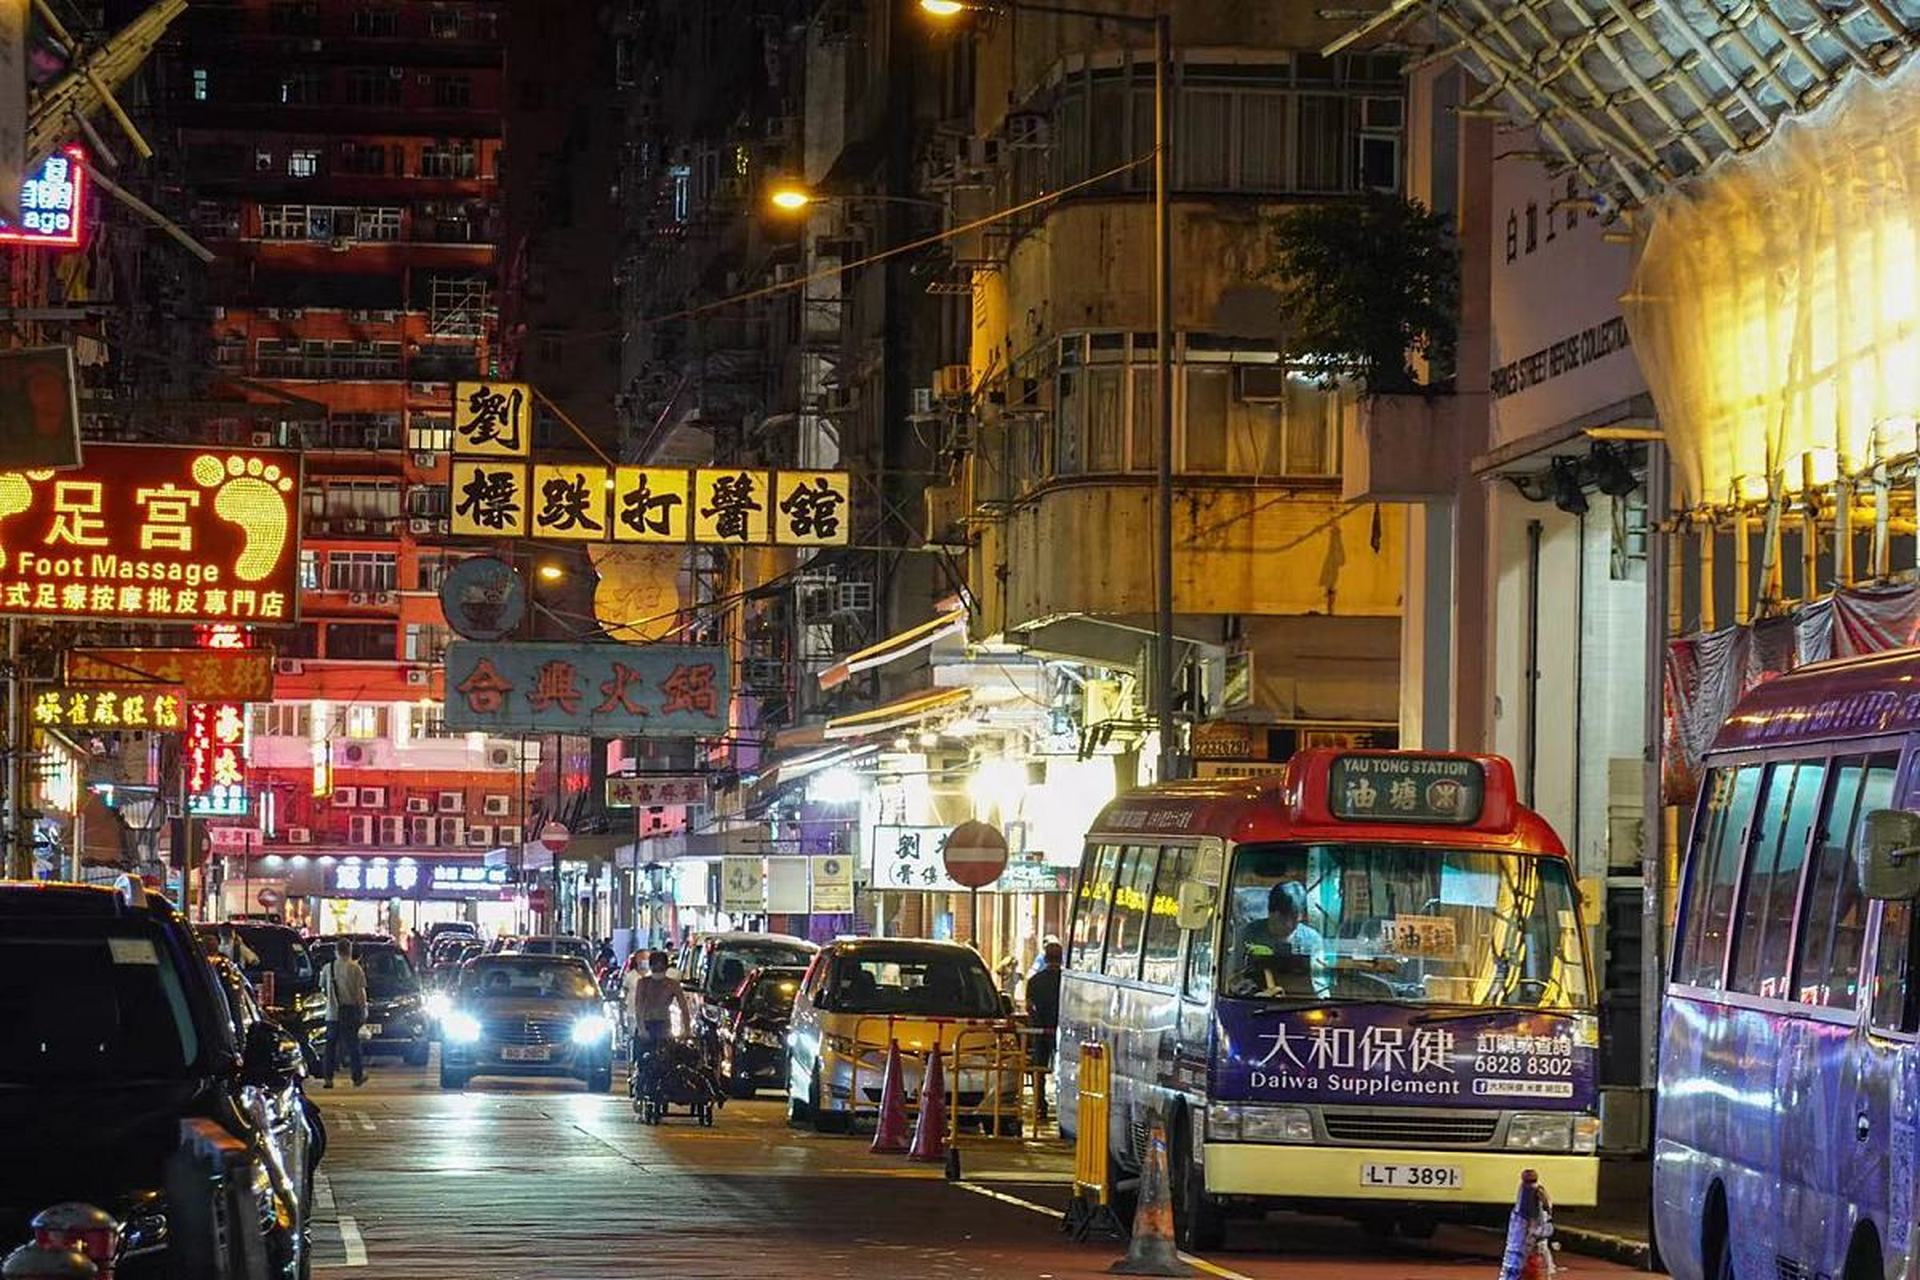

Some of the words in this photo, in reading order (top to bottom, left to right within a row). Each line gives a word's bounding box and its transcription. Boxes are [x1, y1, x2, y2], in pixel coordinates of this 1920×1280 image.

[1518, 349, 1548, 390] STREET
[458, 386, 521, 450] 劉
[44, 480, 200, 551] 足宮
[18, 552, 85, 578] Foot
[91, 553, 220, 586] Massage
[0, 581, 285, 618] 式足療按摩批皮專門店
[455, 656, 719, 720] 合興火鍋
[1343, 758, 1370, 773] YAU
[1373, 759, 1409, 774] TONG
[1413, 760, 1469, 775] STATION
[1345, 777, 1418, 811] 油塘
[1258, 1022, 1456, 1075] 大和保健
[1474, 1055, 1522, 1074] 6828
[1527, 1057, 1573, 1076] 8302
[1251, 1071, 1318, 1090] Daiwa
[1327, 1073, 1460, 1097] Supplement
[1370, 1166, 1397, 1183] LT
[1407, 1167, 1456, 1185] 3891
